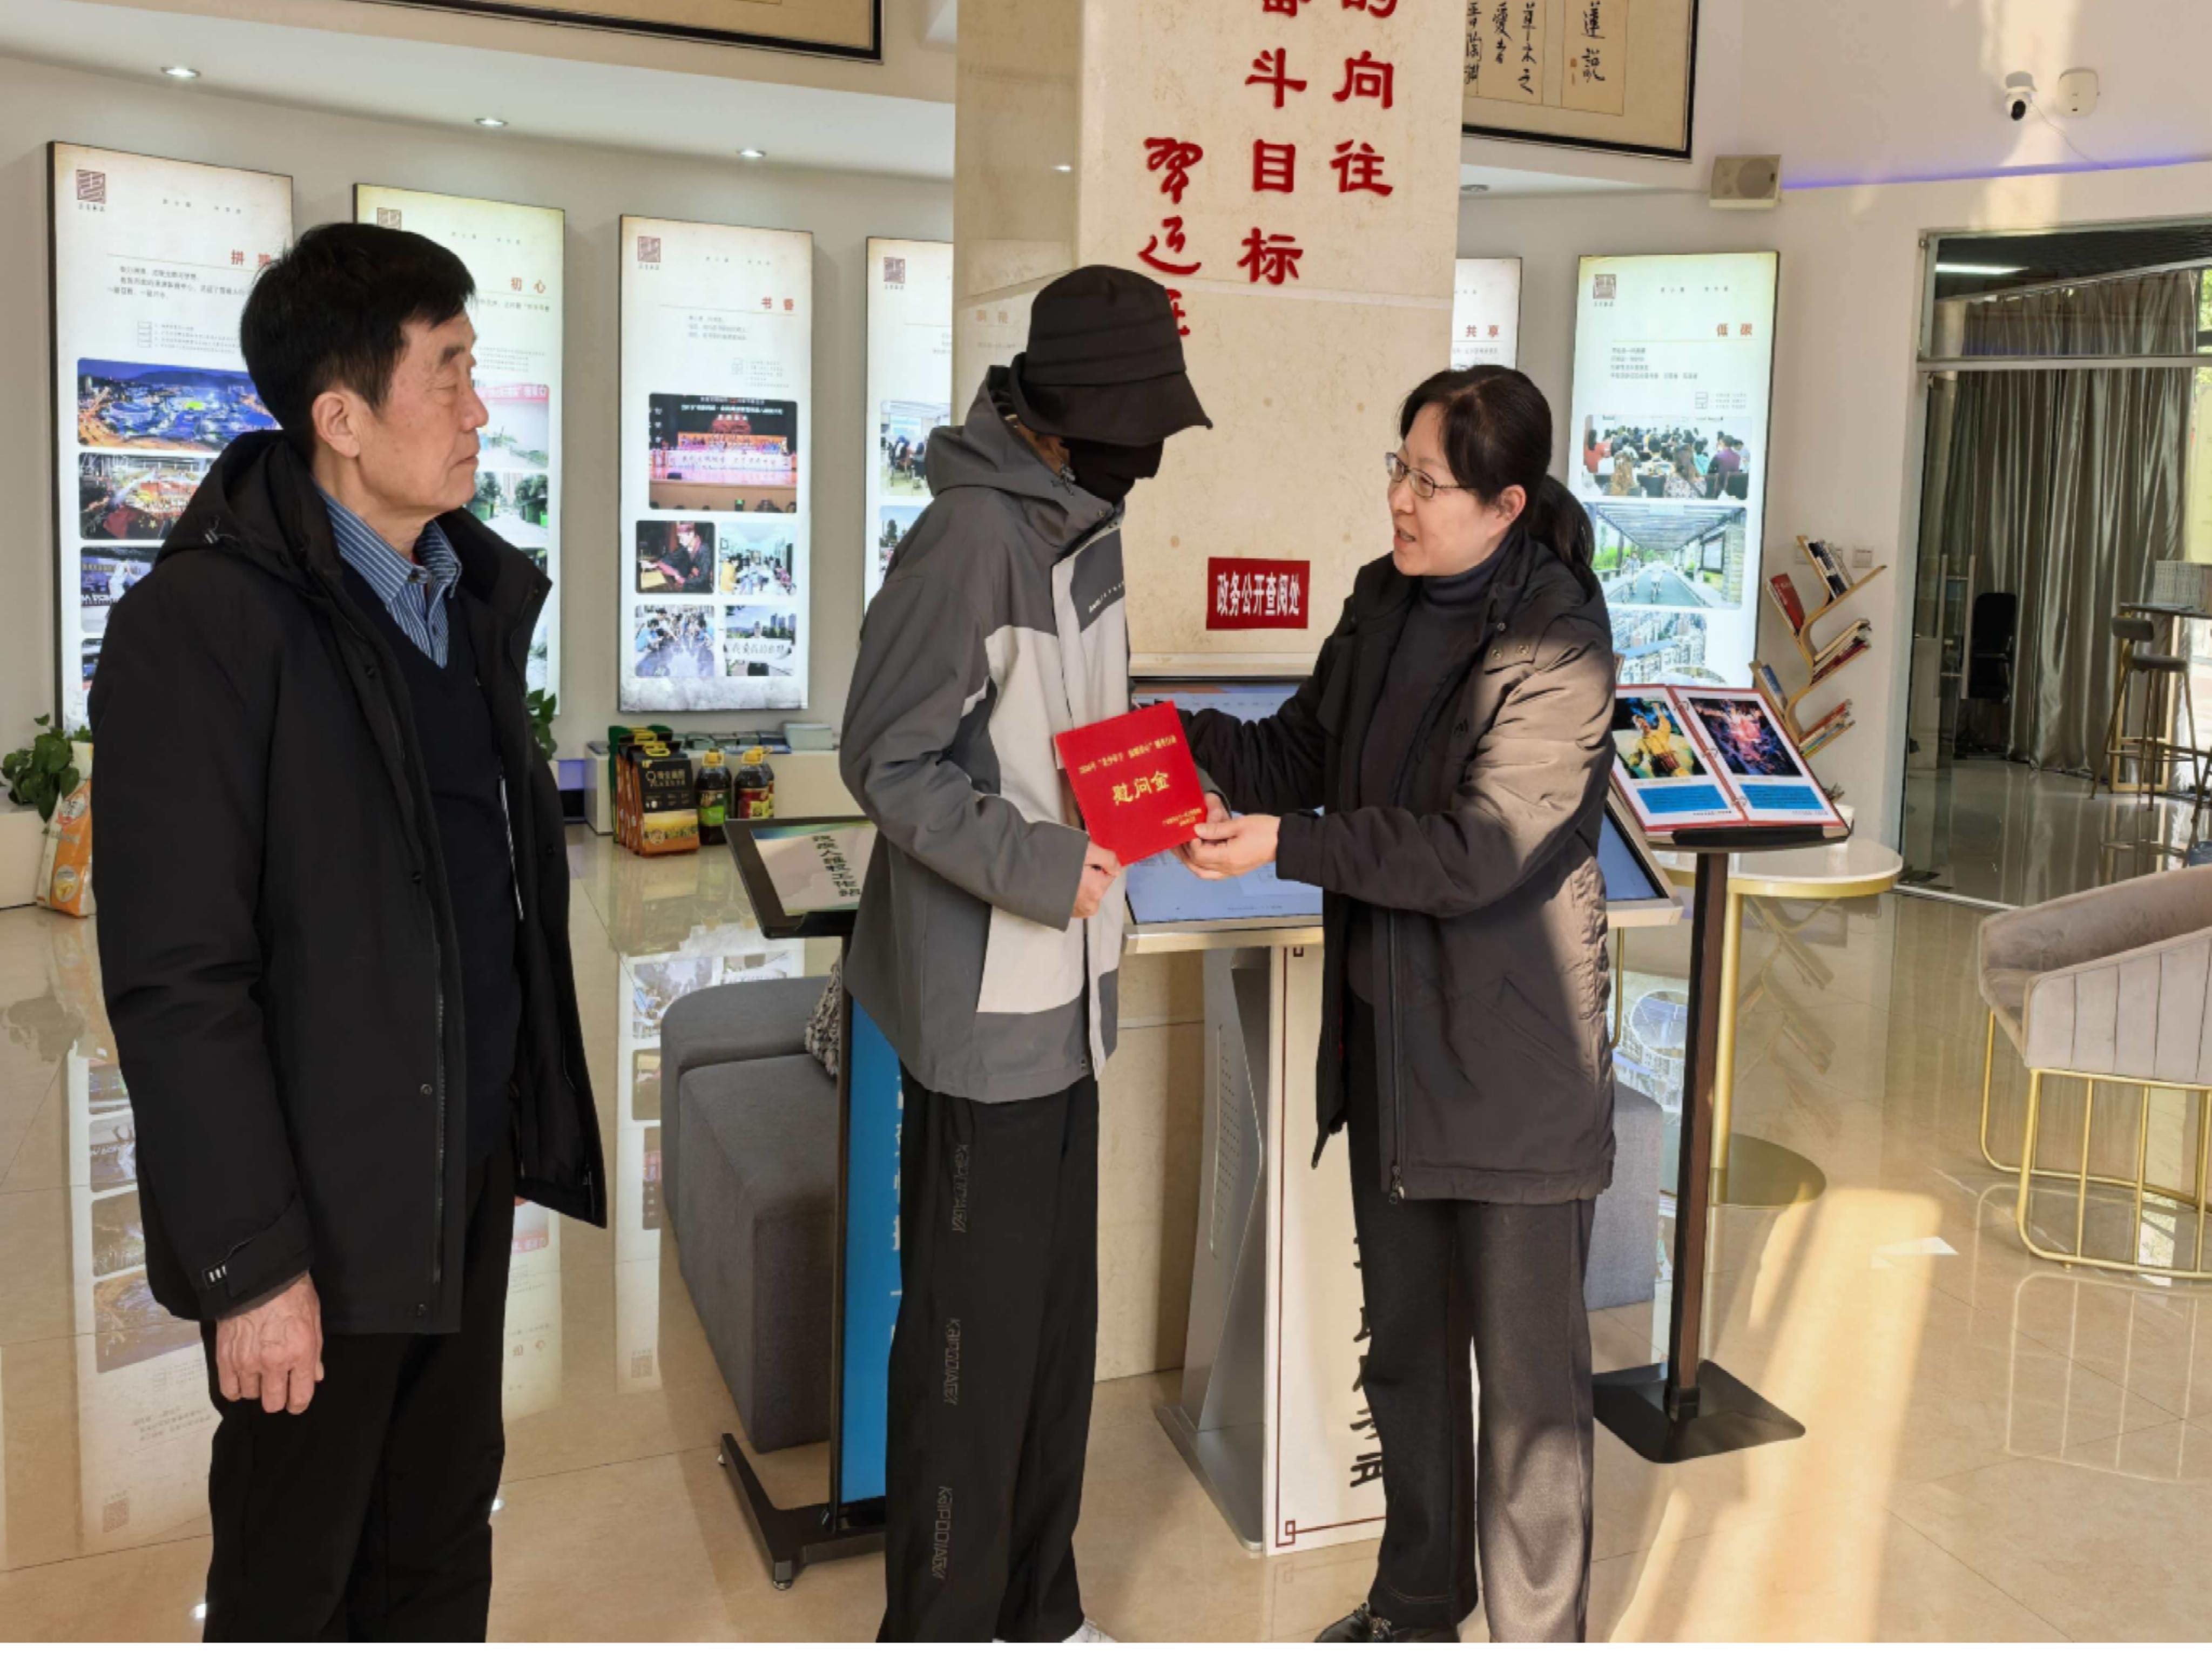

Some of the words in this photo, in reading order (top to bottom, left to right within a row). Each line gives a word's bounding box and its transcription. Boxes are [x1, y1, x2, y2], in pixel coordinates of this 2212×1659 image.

[1237, 0, 1309, 285] 斗目标
[1330, 0, 1397, 197] 向往
[1217, 571, 1300, 616] 政务公开查阅处
[1112, 770, 1170, 806] 慰问金
